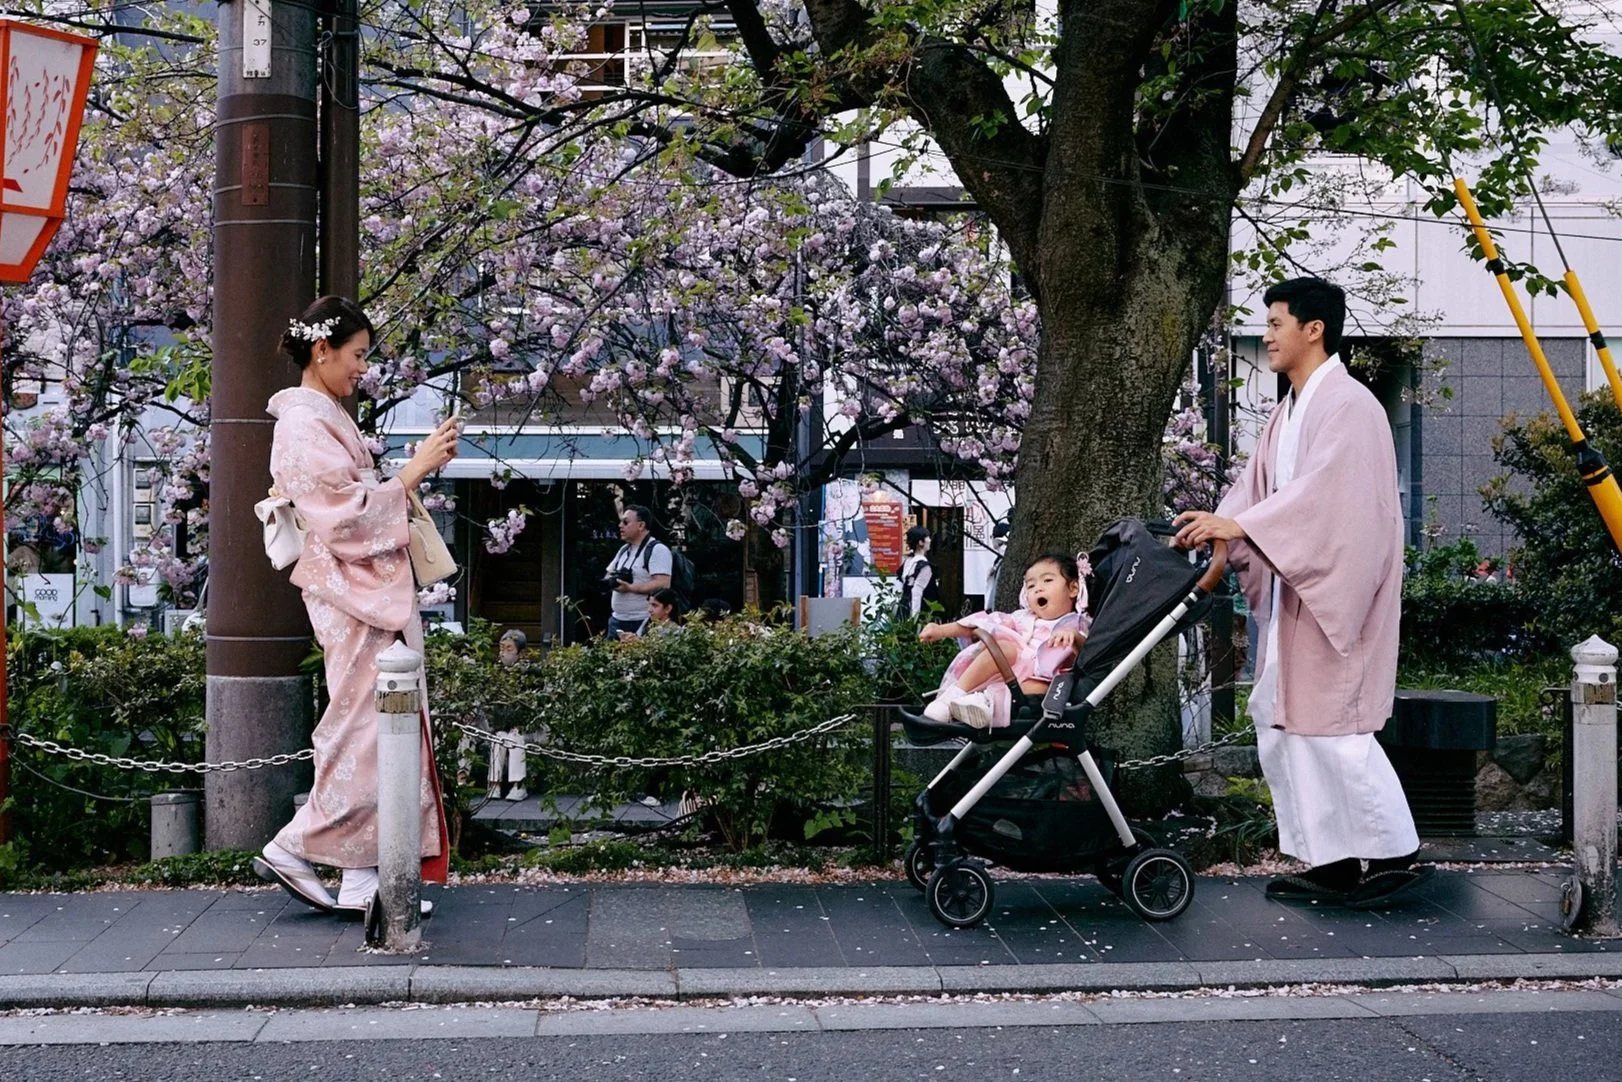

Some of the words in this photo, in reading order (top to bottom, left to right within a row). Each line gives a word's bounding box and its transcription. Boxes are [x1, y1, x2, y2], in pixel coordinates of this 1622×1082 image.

[1126, 556, 1141, 583] nuna
[35, 588, 58, 596] GOOD
[1053, 681, 1065, 700] nuna
